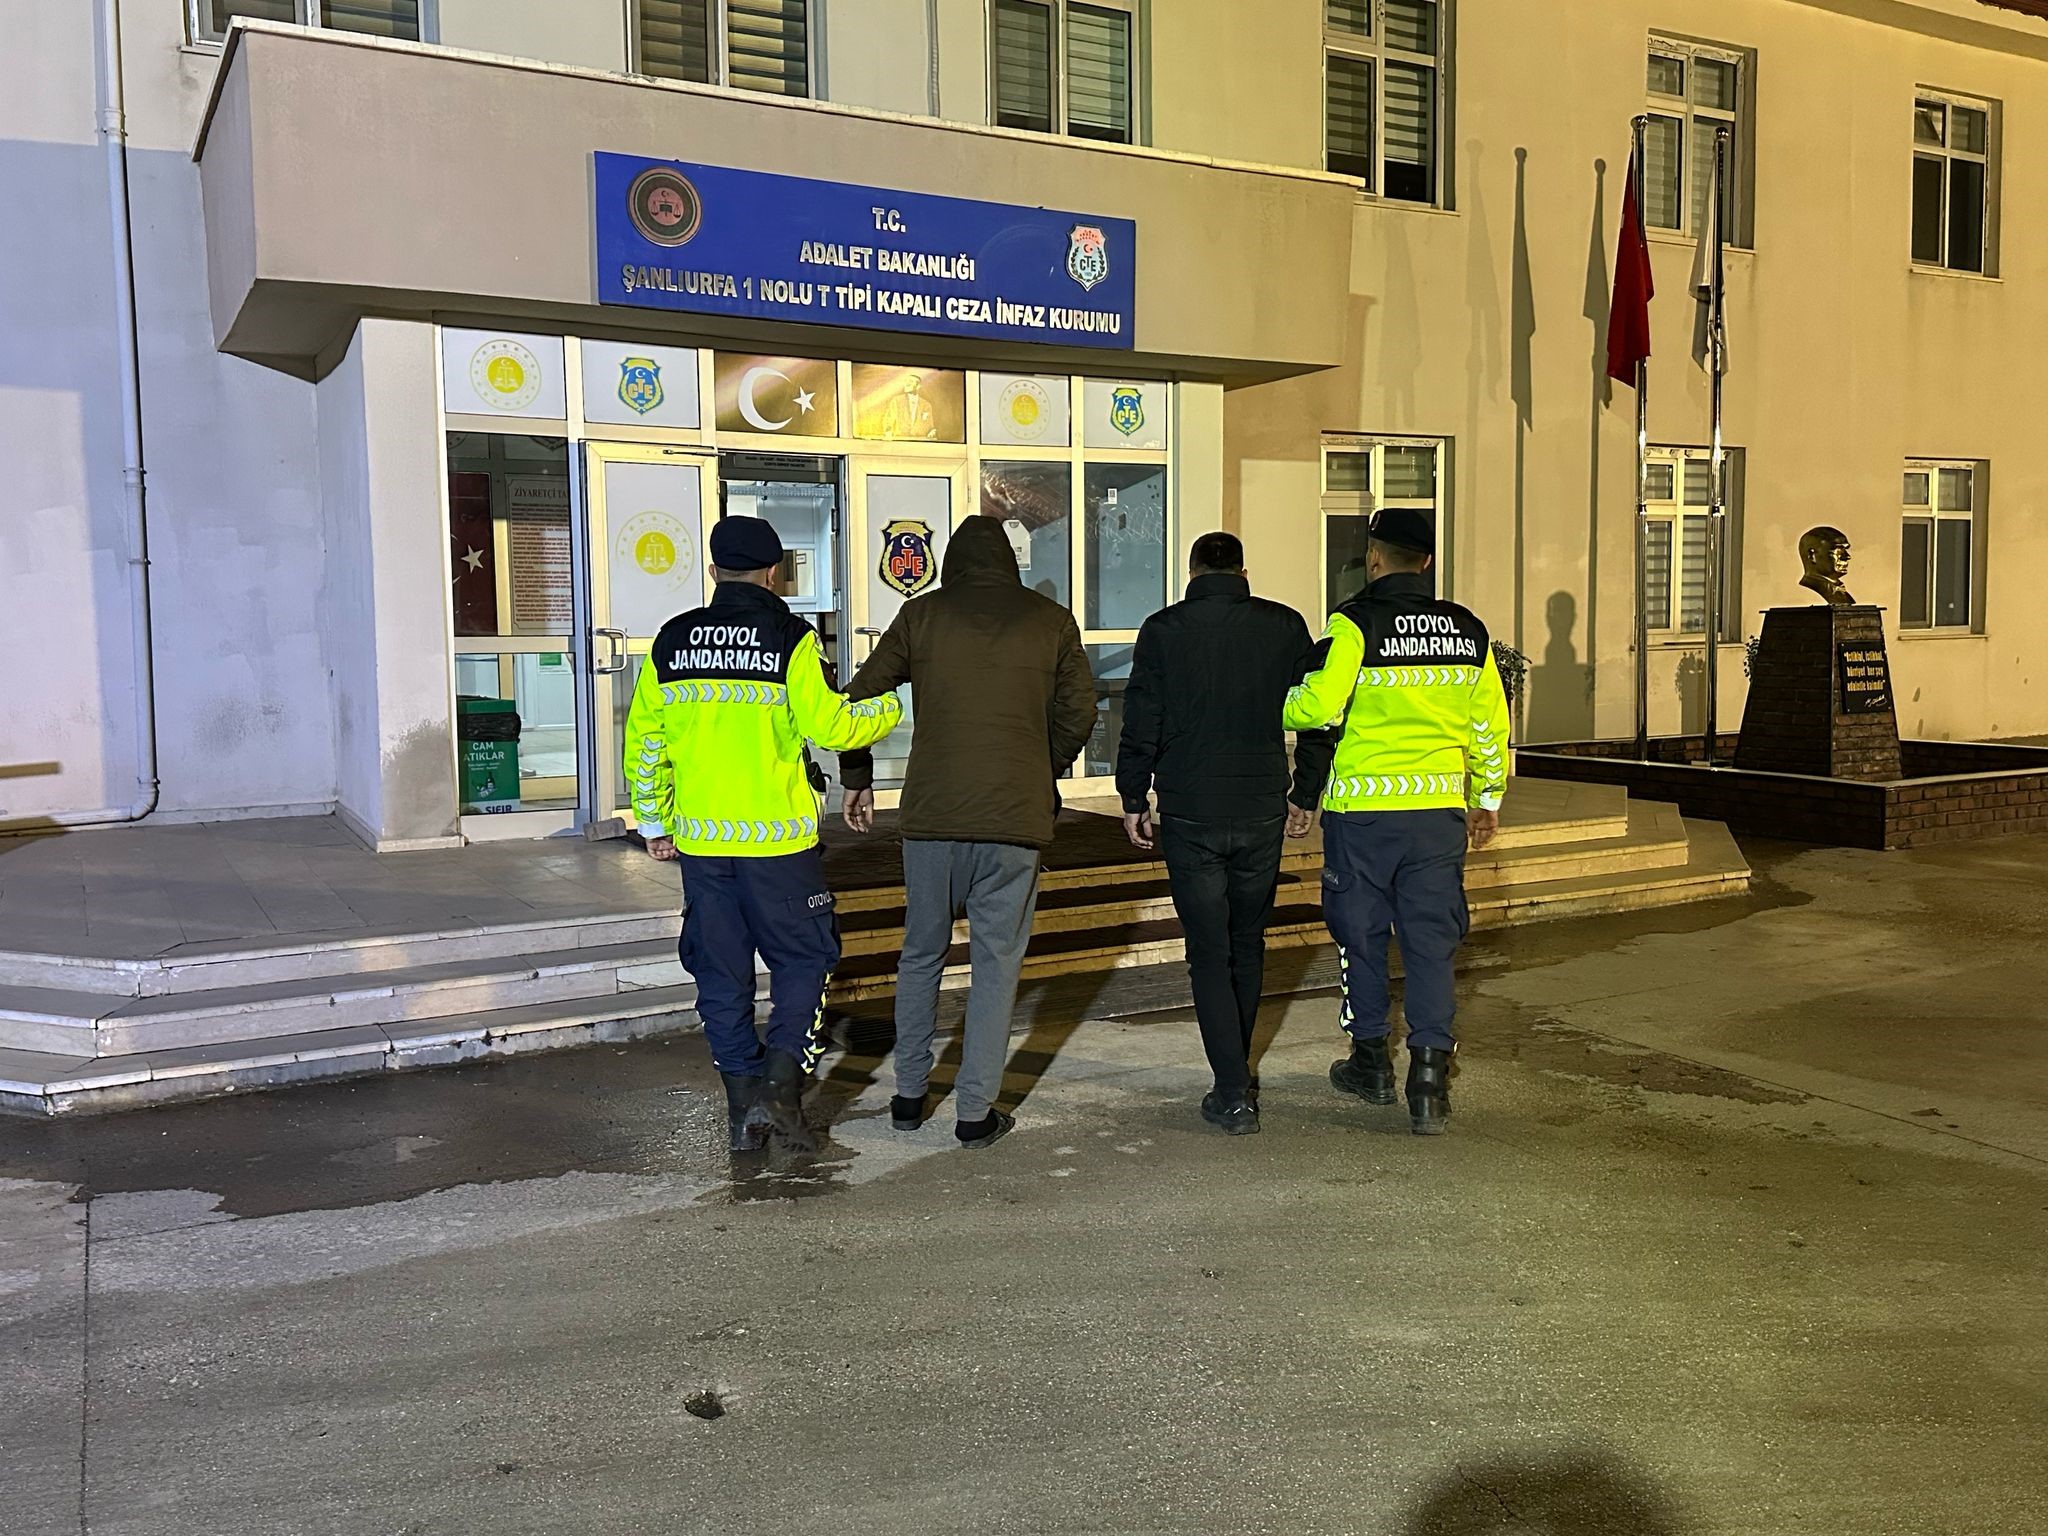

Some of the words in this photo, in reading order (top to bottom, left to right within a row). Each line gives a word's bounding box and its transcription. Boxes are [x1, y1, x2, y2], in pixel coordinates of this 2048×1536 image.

[872, 207, 906, 232] T.C.
[799, 240, 873, 269] ADALET
[877, 249, 975, 281] BAKANLIĞI
[622, 264, 738, 298] ŞANLIURFA
[742, 276, 753, 299] 1
[759, 278, 812, 306] NOLU
[817, 284, 831, 307] T
[835, 282, 872, 311] TİPİ
[877, 290, 942, 319] KAPALI
[945, 298, 992, 324] CEZA
[996, 296, 1045, 328] İNFAZ
[1049, 308, 1122, 334] KURUMU
[514, 486, 556, 499] ZİYARETÇİ
[891, 548, 924, 577] CTE
[1394, 614, 1460, 634] OTOYOL
[689, 625, 761, 647] OTOYOL
[1379, 636, 1477, 658] JANDARMASI
[668, 648, 781, 673] JANDARMASI
[463, 751, 505, 761] ATIKLAR
[472, 741, 494, 751] CAM
